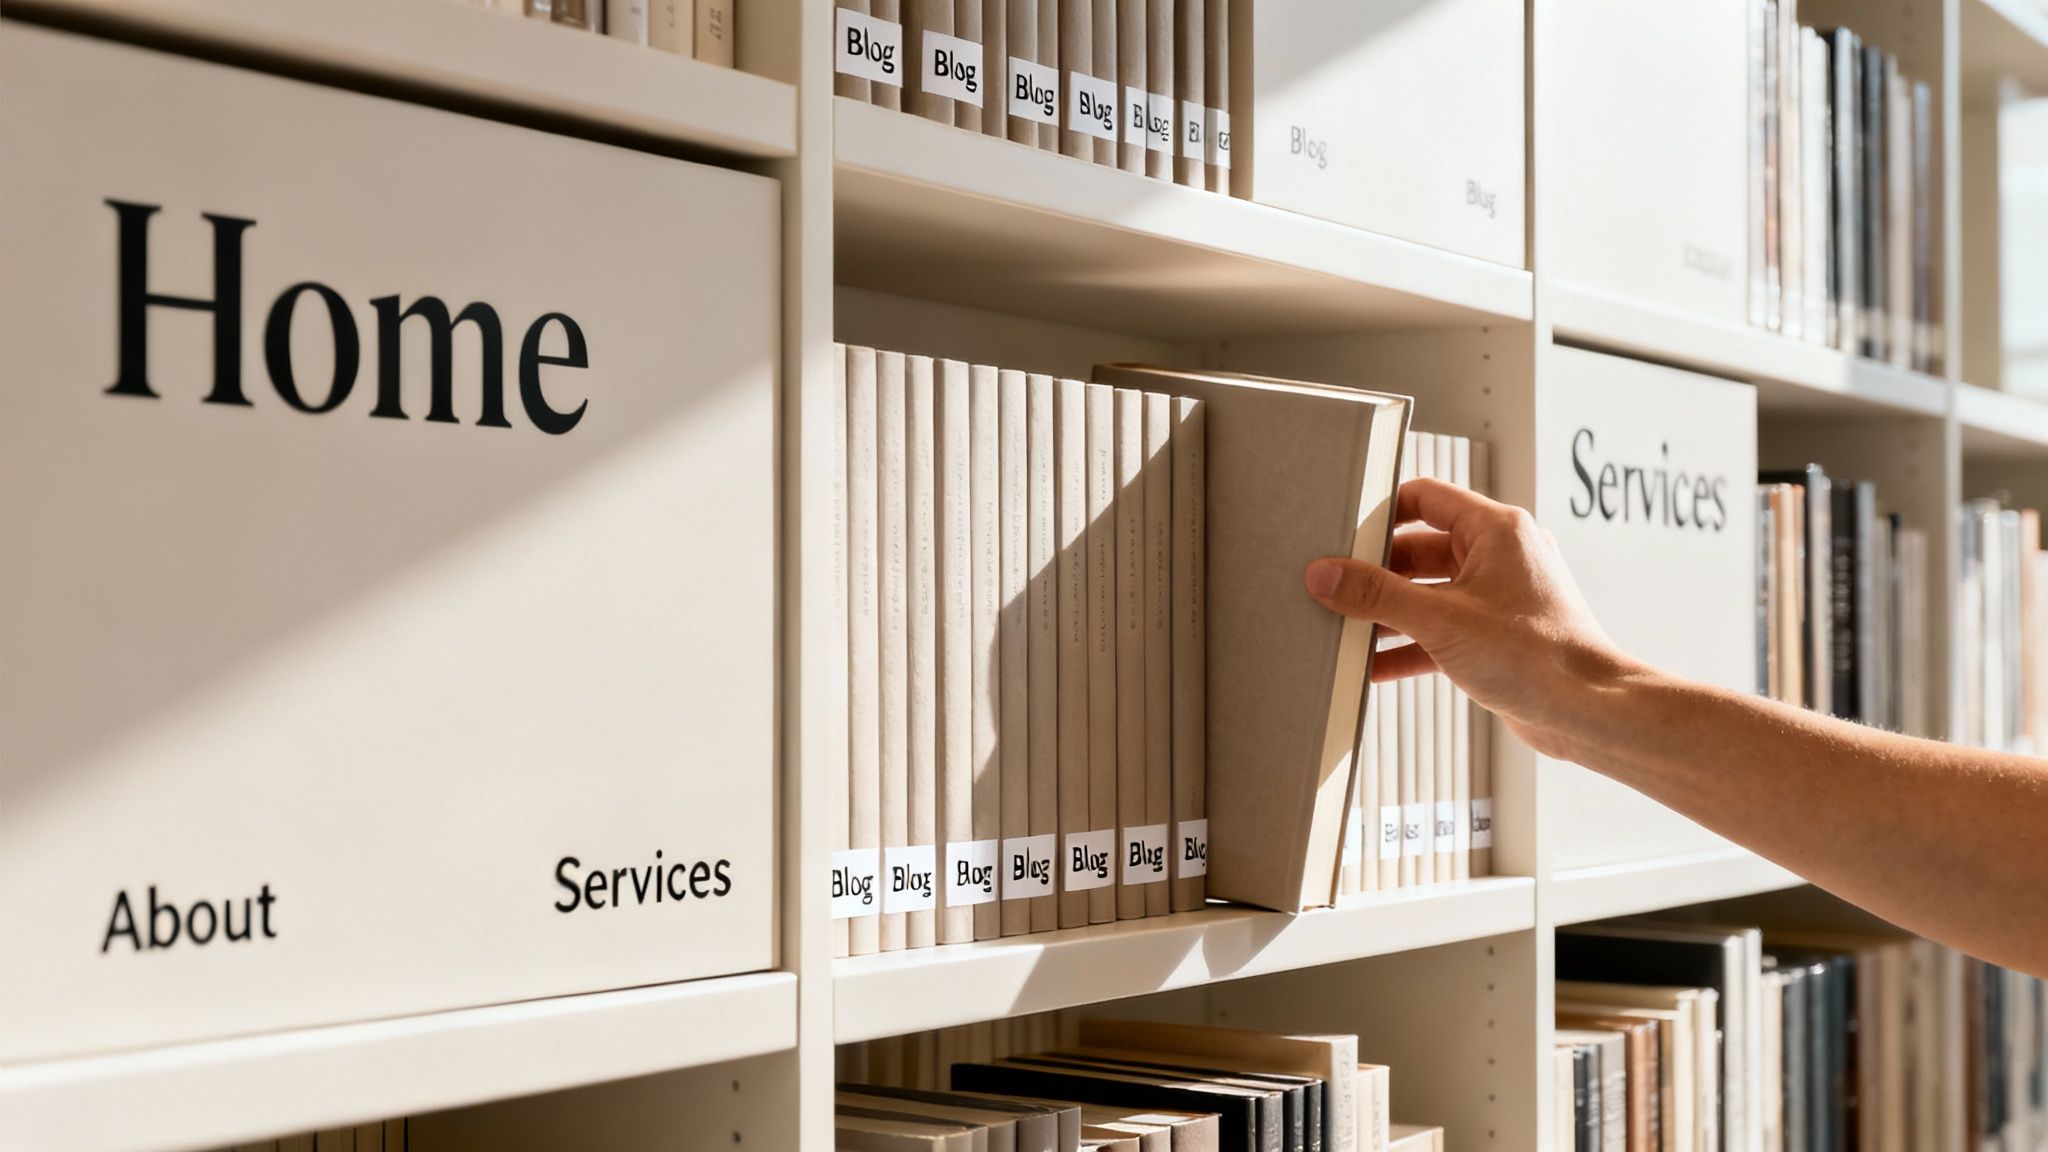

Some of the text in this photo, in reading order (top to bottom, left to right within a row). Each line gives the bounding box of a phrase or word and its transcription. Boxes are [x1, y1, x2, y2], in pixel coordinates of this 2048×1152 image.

[846, 26, 895, 74] Blog
[933, 49, 978, 93] Blog
[1015, 73, 1055, 116] Blog
[1290, 125, 1328, 169] Blog
[105, 199, 590, 436] Home
[1570, 428, 1727, 532] Services
[554, 850, 732, 913] Services
[892, 863, 932, 898] Blog
[1013, 846, 1051, 886] Blog
[1072, 844, 1109, 879] Blog
[831, 866, 874, 905] Blog
[102, 886, 278, 953] About
